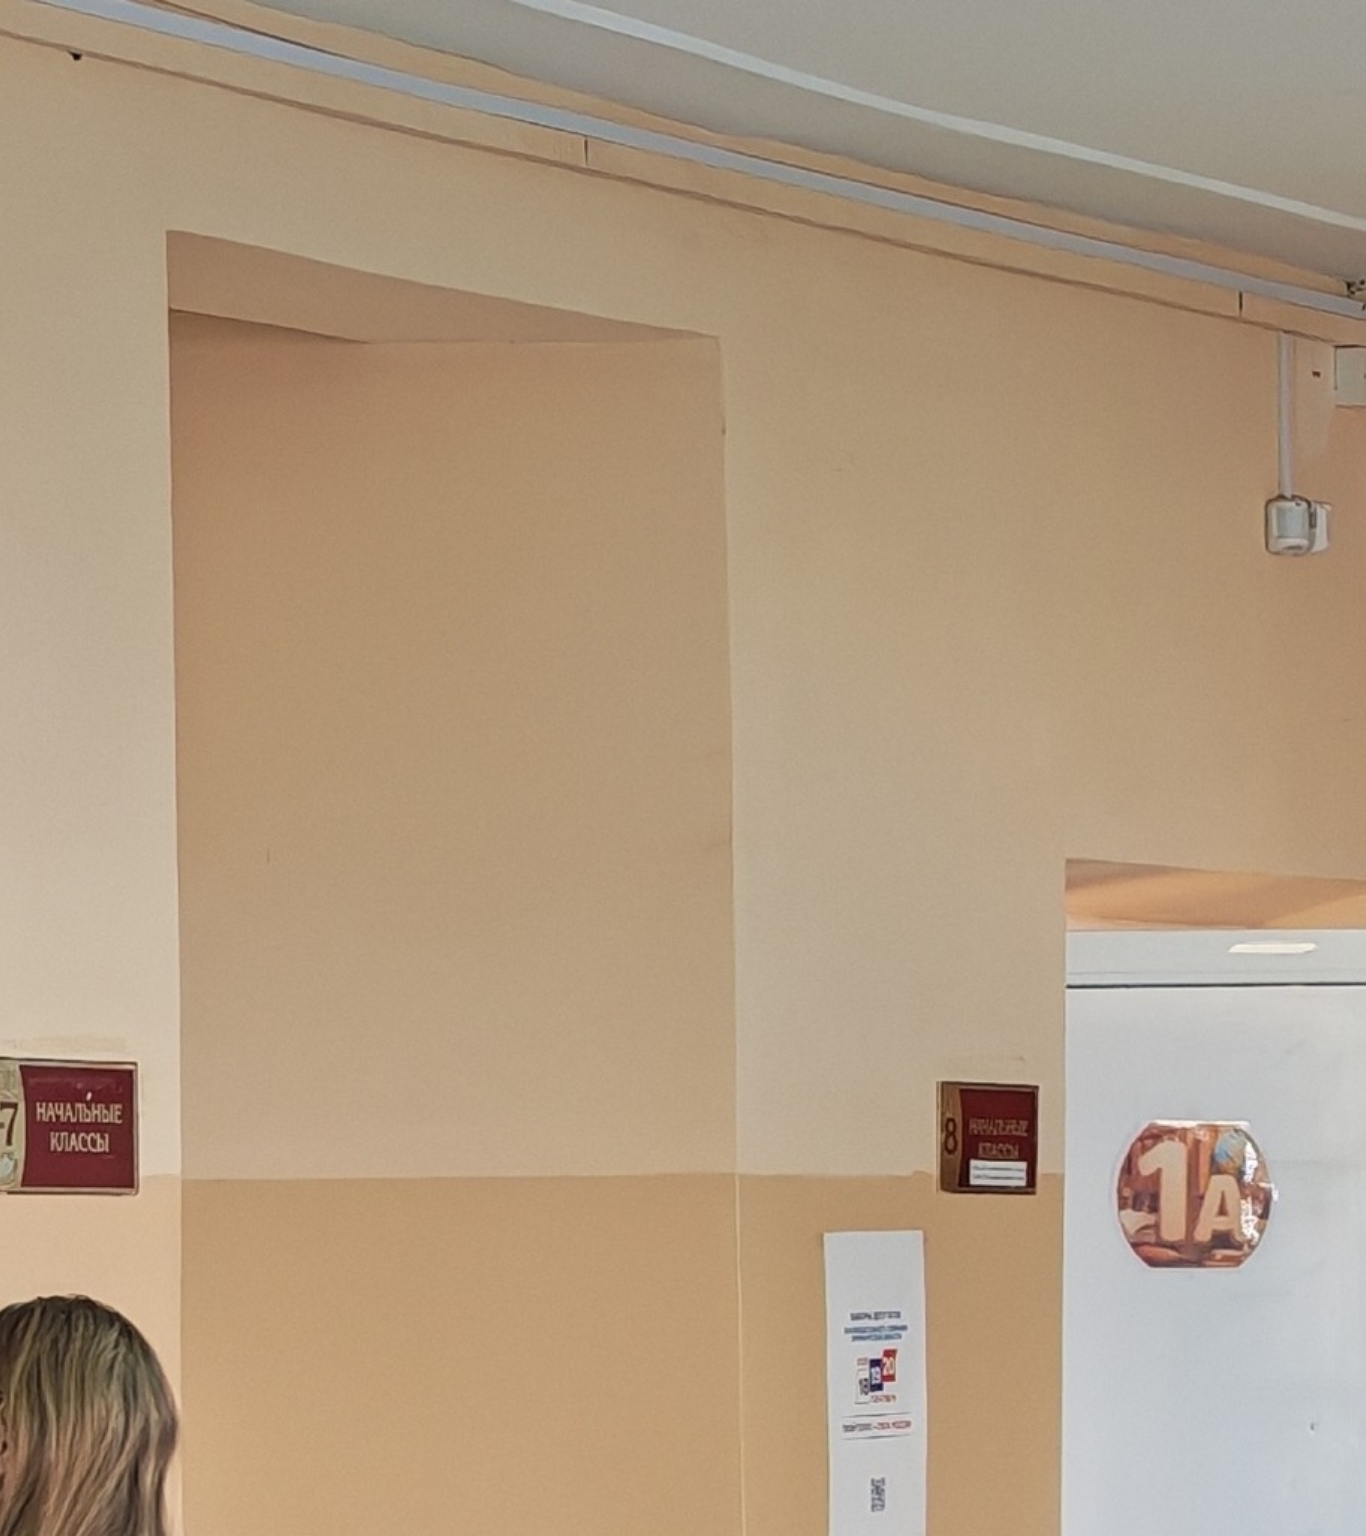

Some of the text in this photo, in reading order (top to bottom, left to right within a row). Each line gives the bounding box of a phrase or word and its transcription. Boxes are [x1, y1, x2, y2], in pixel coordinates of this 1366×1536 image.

[0, 1101, 19, 1147] 7
[35, 1101, 123, 1124] НАЧАЛЬНЫЕ
[49, 1131, 110, 1153] КЛАССЫ
[943, 1117, 959, 1155] 8
